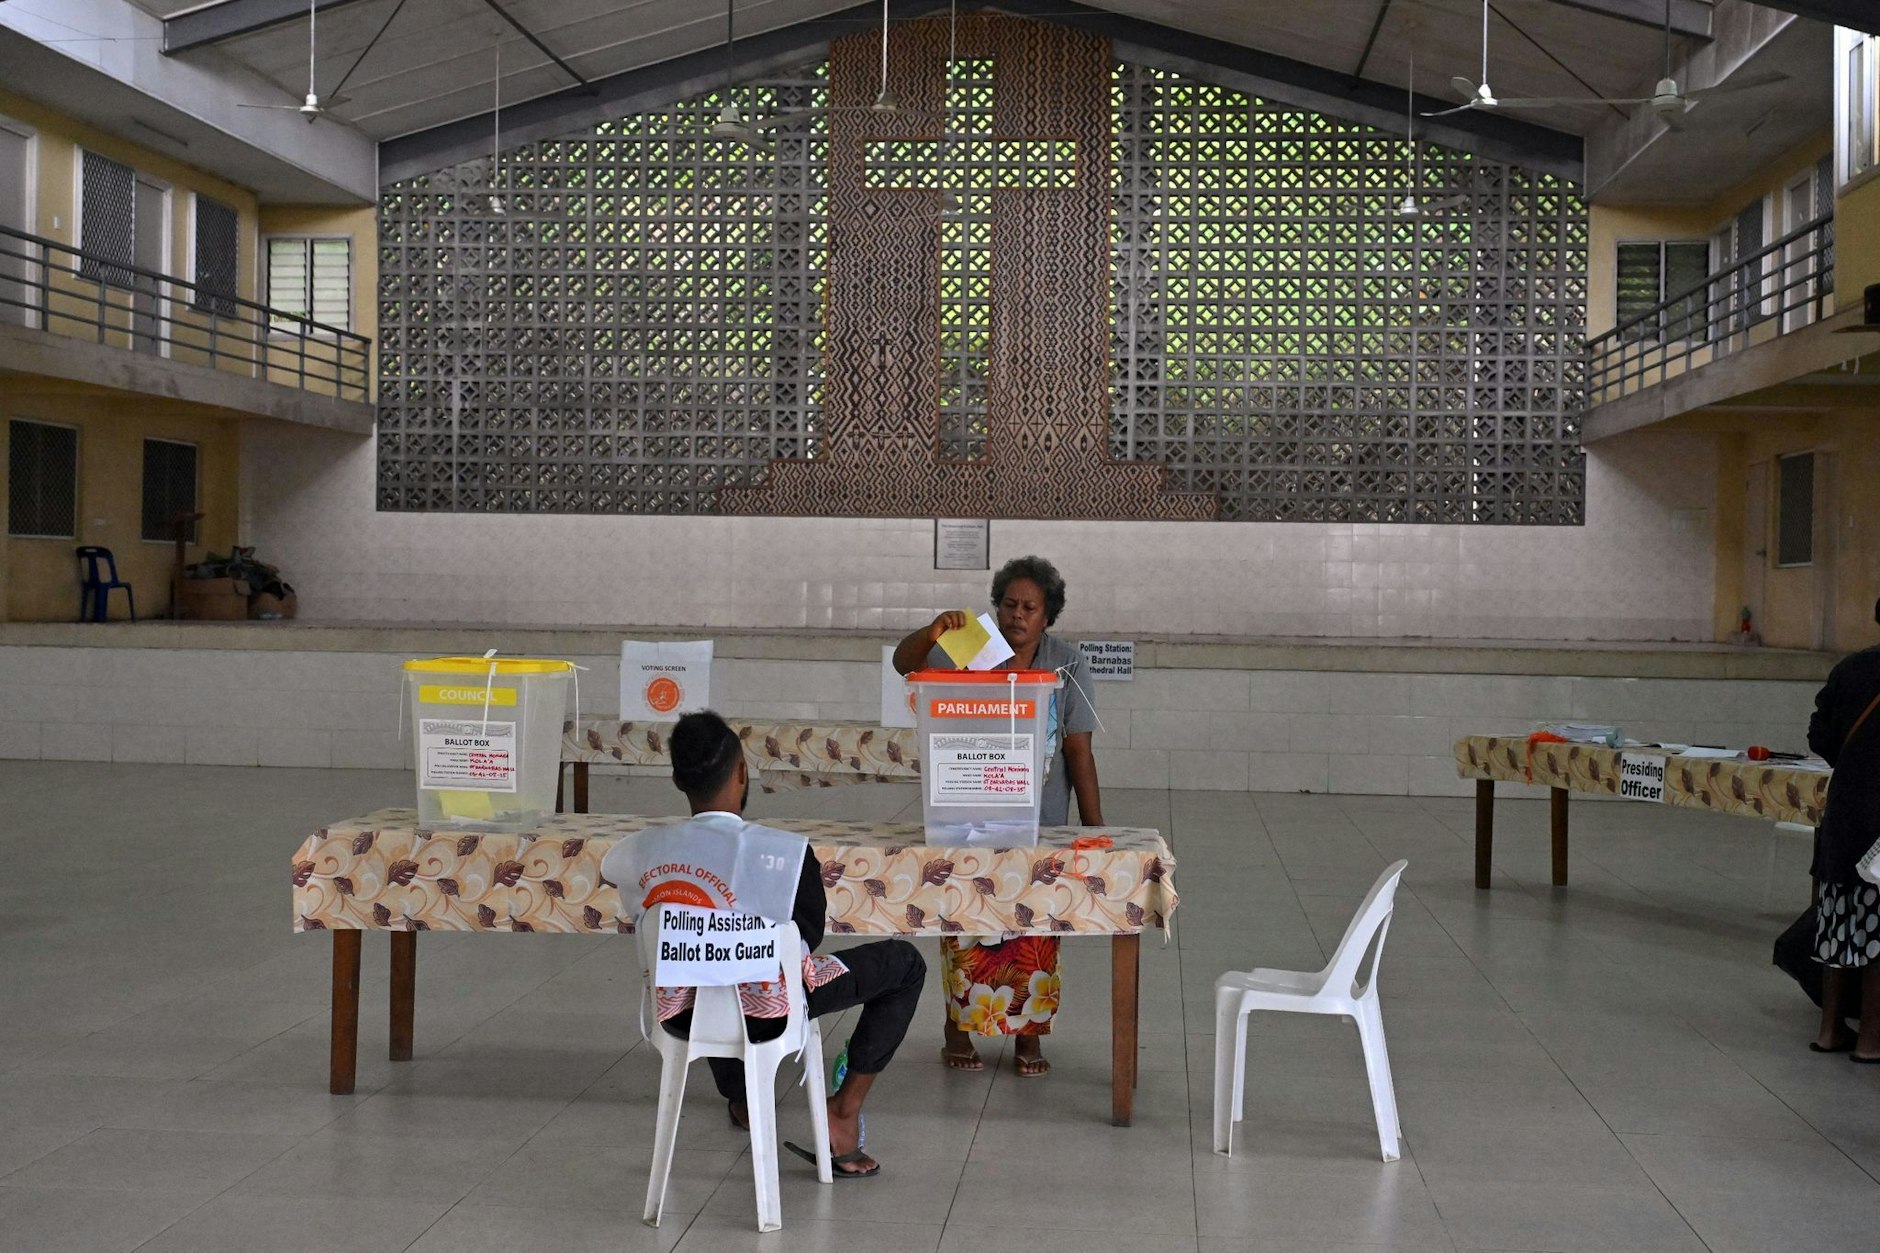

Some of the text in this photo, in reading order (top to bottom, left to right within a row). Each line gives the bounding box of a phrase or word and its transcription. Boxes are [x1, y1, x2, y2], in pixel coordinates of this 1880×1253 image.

[1080, 643, 1132, 654] Polling Station:
[1091, 655, 1132, 665] Barnabas
[1117, 666, 1132, 674] Hall
[937, 703, 1028, 715] PARLIAMENT
[444, 738, 490, 747] BALLOT BOX
[1621, 759, 1663, 782] Presiding
[1621, 779, 1662, 799] Officer
[695, 867, 737, 908] OFFICIAL
[664, 910, 704, 936] Polling
[661, 940, 775, 962] Ballot Box Guard
